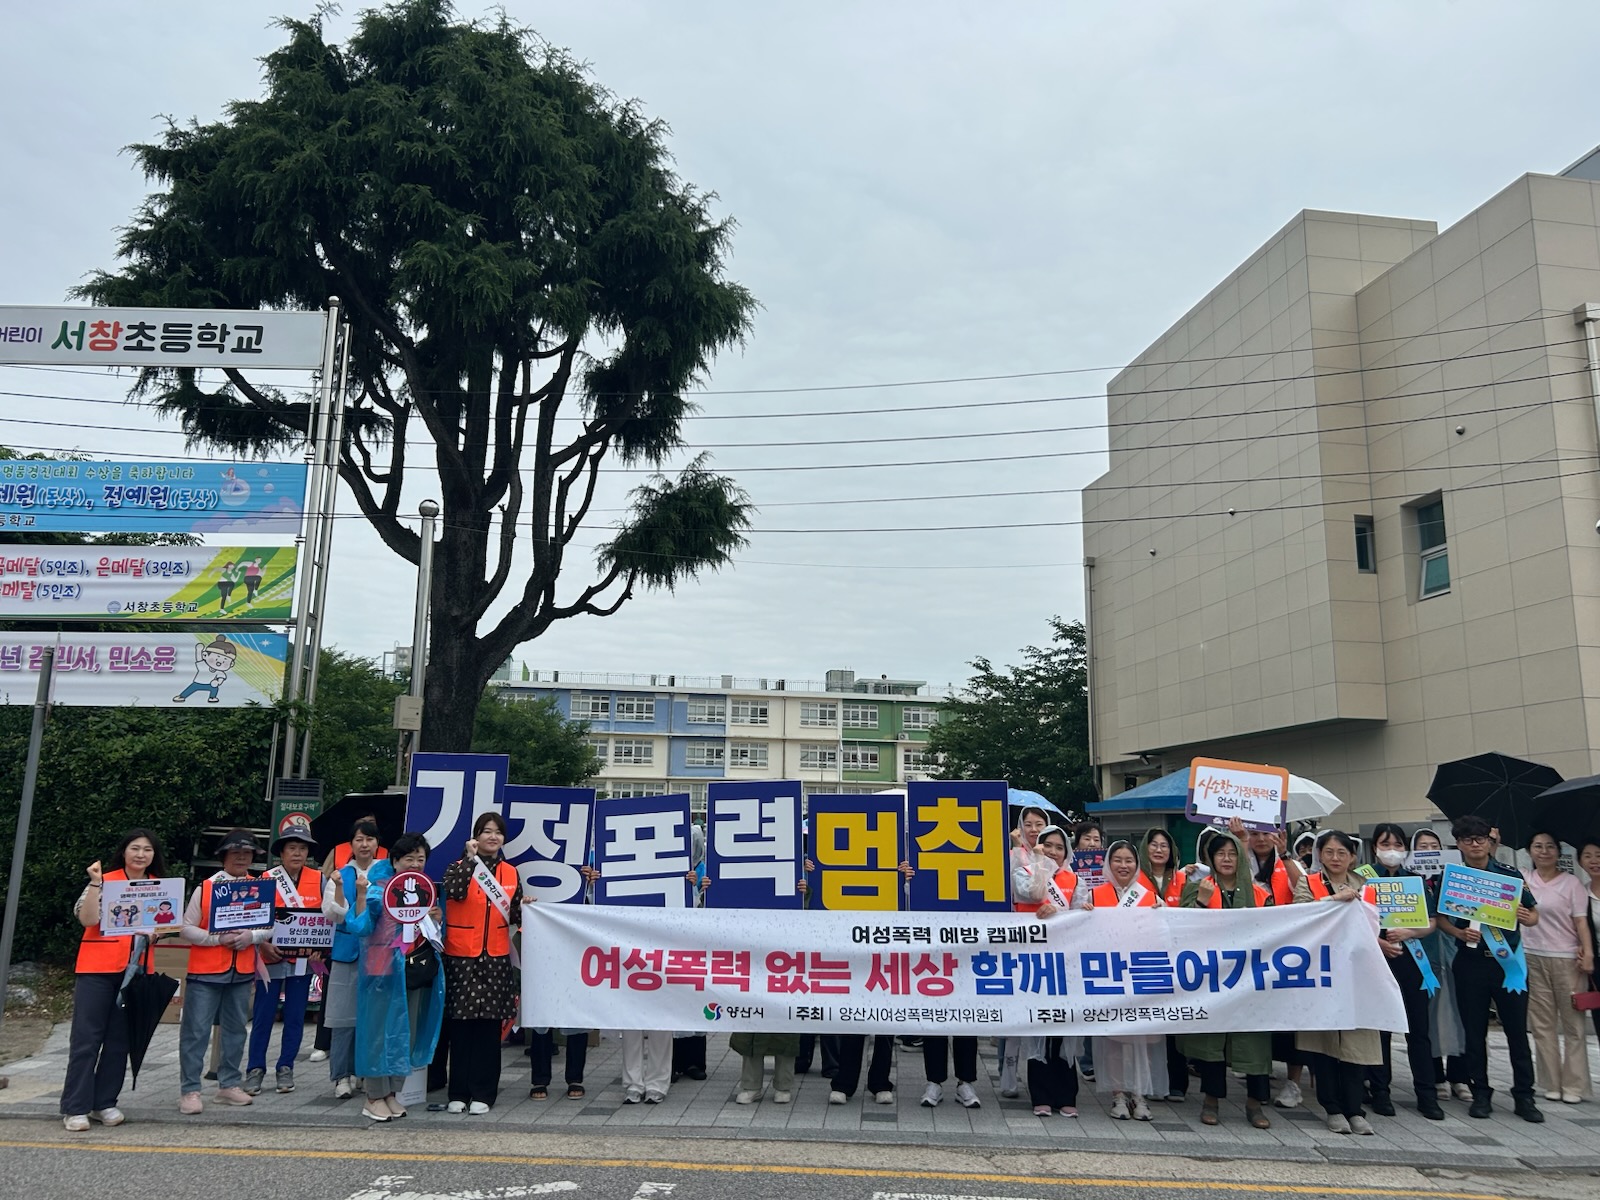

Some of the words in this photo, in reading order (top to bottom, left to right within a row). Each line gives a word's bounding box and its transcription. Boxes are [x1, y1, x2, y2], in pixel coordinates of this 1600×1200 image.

[51, 320, 264, 354] 서창초등학교
[3, 465, 79, 480] 명품경진대회
[85, 465, 123, 481] 수상을
[129, 466, 195, 481] 축하합니다
[103, 484, 220, 510] 전예원(동상)
[96, 556, 191, 577] 은메달(3인조)
[0, 580, 82, 600] 메달(5인조)
[124, 601, 199, 613] 서창초등학교
[109, 646, 175, 672] 민소윤
[1198, 776, 1232, 800] 사소한
[1234, 785, 1279, 802] 가정폭력은
[1217, 796, 1255, 813] 없습니다.
[213, 883, 234, 900] NO!
[398, 909, 421, 918] STOP
[289, 928, 309, 936] 당신의
[310, 928, 331, 936] 관심이
[852, 926, 931, 944] 여성폭력
[940, 926, 979, 943] 예방
[987, 924, 1048, 944] 캠페인
[276, 937, 297, 945] 예방의
[298, 937, 332, 946] 시작입니다
[581, 946, 750, 993] 여성폭력
[765, 951, 852, 994] 없는
[865, 952, 958, 996] 세상
[971, 951, 1067, 996] 함께
[1080, 945, 1332, 996] 만들어가요!
[726, 1006, 764, 1019] 양산시
[796, 1006, 824, 1021] 주최
[839, 1007, 1003, 1023] 양산시여성폭력방지위원회
[1037, 1008, 1066, 1023] 주관
[1083, 1006, 1208, 1022] 양산가정폭력상담소
